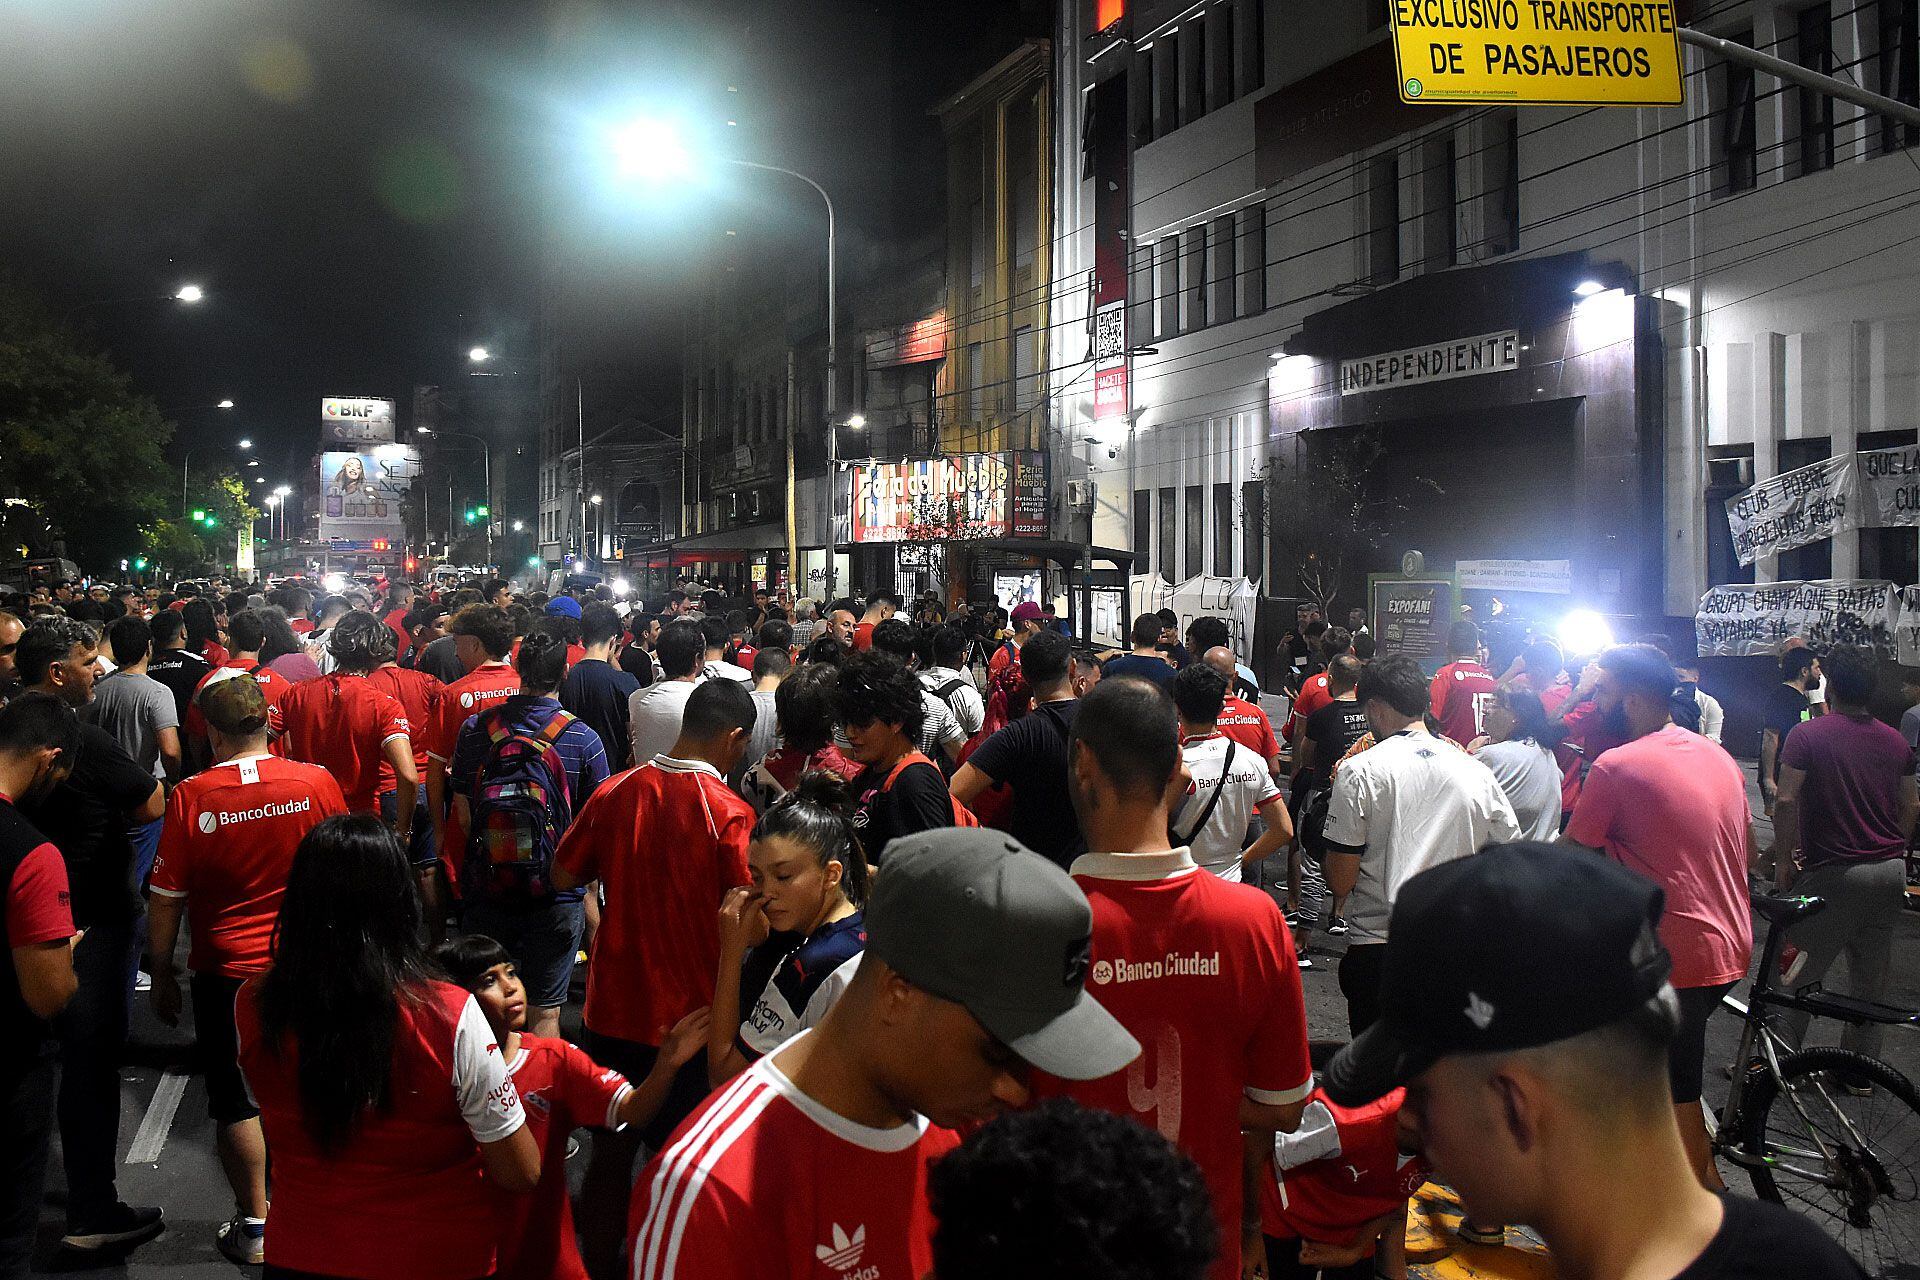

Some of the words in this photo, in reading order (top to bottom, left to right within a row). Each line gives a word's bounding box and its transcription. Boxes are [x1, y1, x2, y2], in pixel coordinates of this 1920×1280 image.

[1397, 0, 1519, 30] EXCLUSIVO
[1529, 0, 1673, 34] TRANSPORTE
[1429, 43, 1465, 75] DE
[1484, 43, 1651, 78] PASAJEROS
[1343, 336, 1517, 391] INDEPENDIENTE
[1017, 464, 1044, 479] Feria
[1866, 451, 1899, 477] QUE
[859, 472, 904, 518] Feria
[908, 461, 934, 496] del
[939, 459, 1008, 495] Mueble
[1015, 479, 1048, 488] Mueble
[1737, 488, 1770, 521] CLUB
[1782, 464, 1832, 501] POBRE
[1810, 493, 1846, 527] RICOS
[1388, 599, 1431, 614] EXPOFAN!
[1706, 592, 1746, 614] GRUPO
[1754, 587, 1830, 612] CHAMPAGNE
[1837, 586, 1886, 611] RATAS
[1772, 616, 1788, 640] YA
[473, 686, 520, 701] BancoCiu
[1217, 717, 1235, 726] anco
[1235, 714, 1261, 725] Ciudad
[219, 796, 311, 826] BancoCiudad
[1115, 958, 1162, 983] Banco
[1165, 951, 1220, 977] Ciudad
